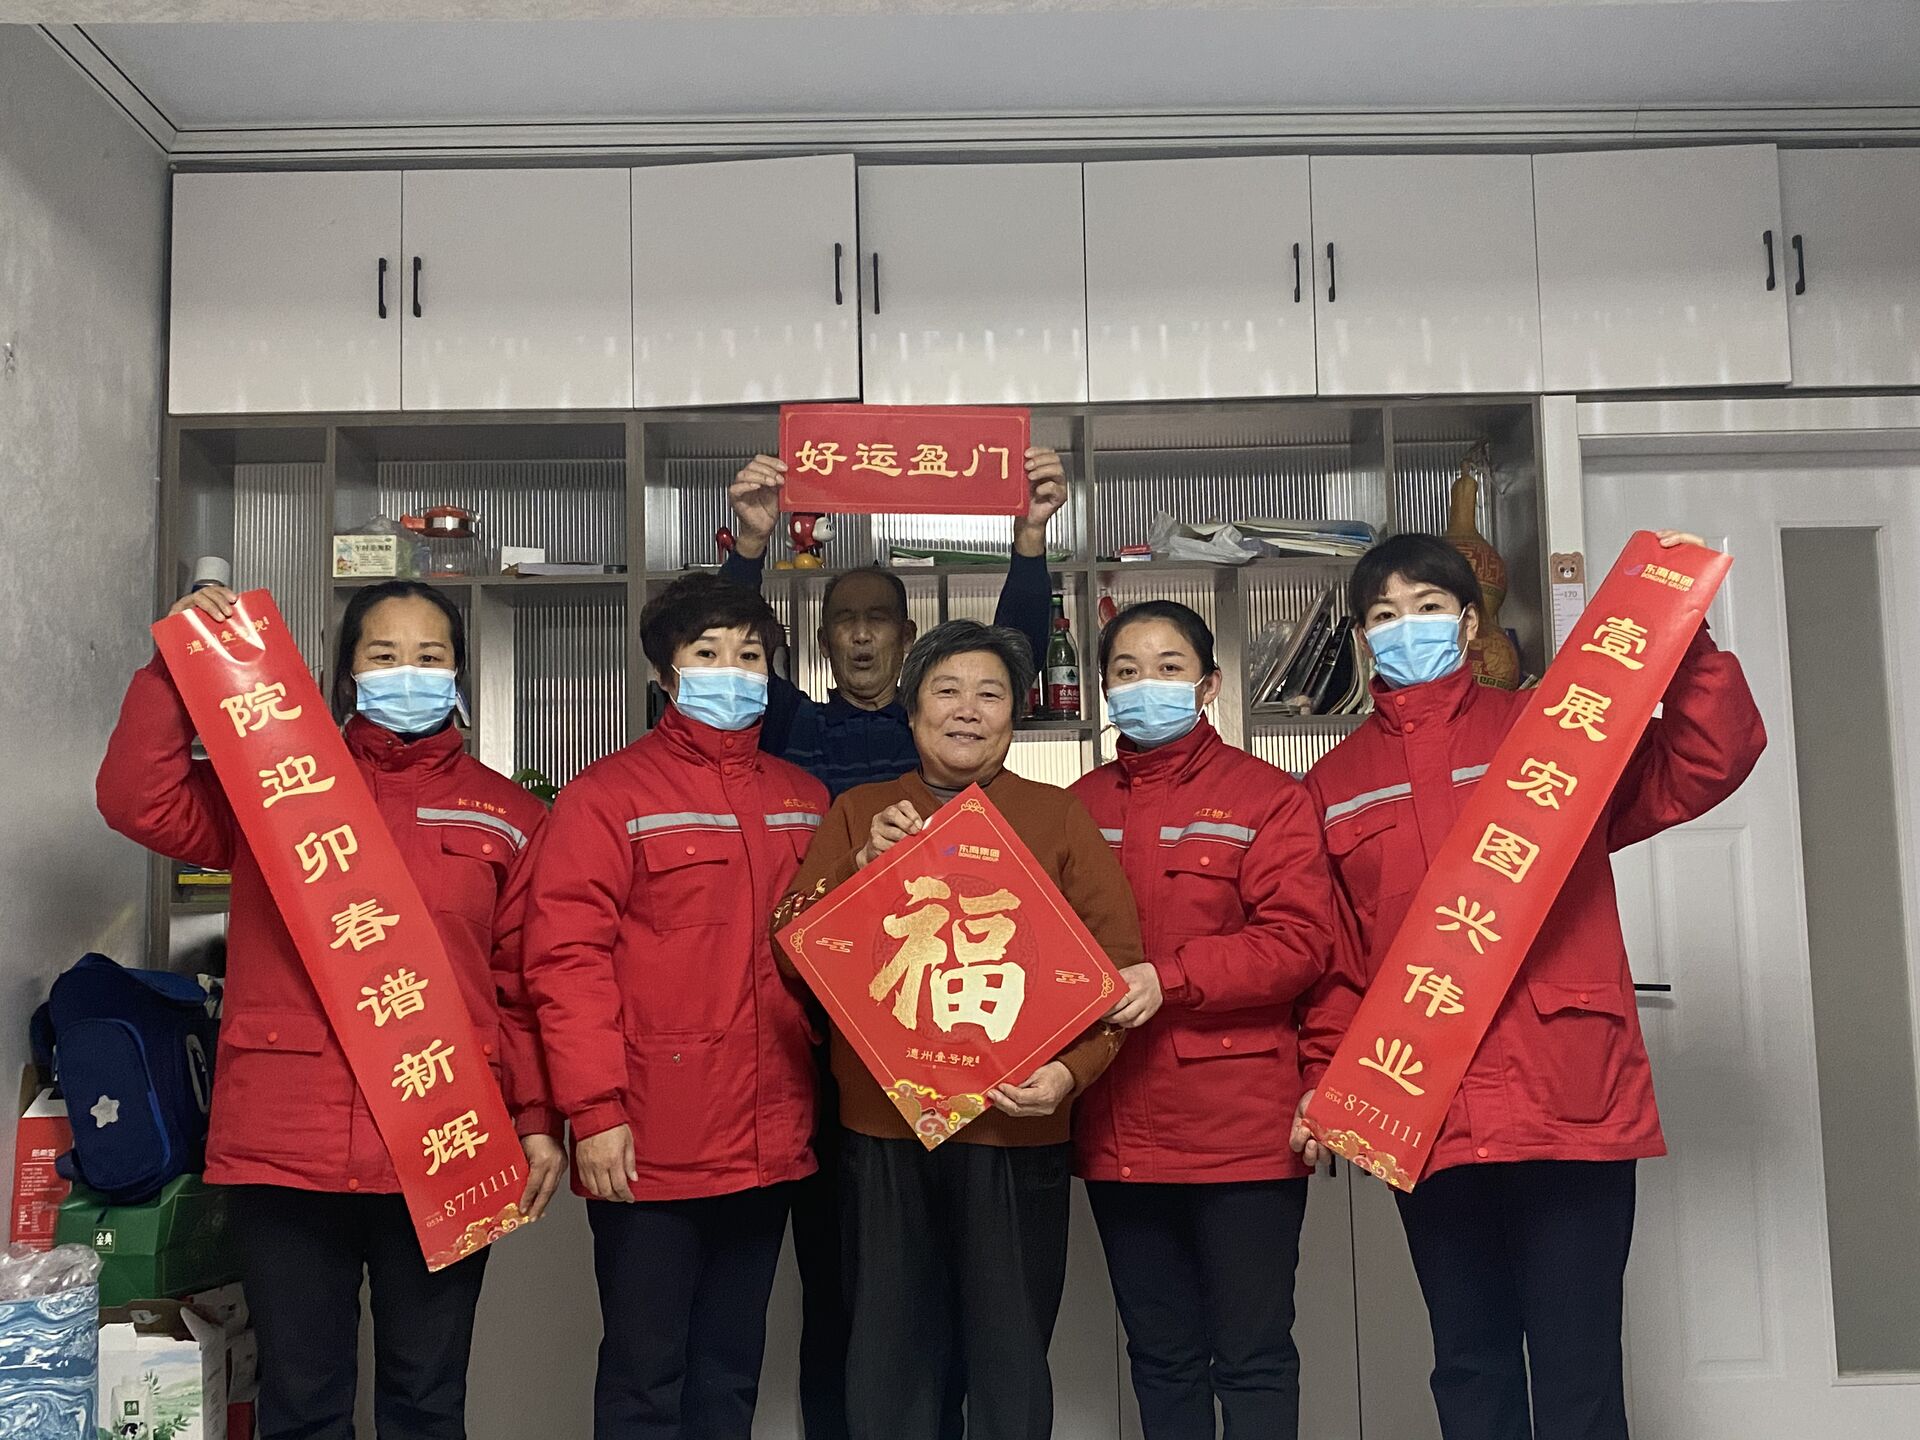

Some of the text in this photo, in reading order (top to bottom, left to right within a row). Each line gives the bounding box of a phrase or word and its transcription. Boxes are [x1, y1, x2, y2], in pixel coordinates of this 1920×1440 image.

[795, 440, 1010, 480] 好运盈门
[186, 619, 268, 655] 德壹院
[1358, 615, 1649, 1096] 壹展宏图兴伟业
[218, 680, 490, 1176] 院迎卯春谱新辉
[868, 875, 1026, 1043] 福
[1344, 1094, 1422, 1149] 8771111
[444, 1164, 520, 1218] 8771111
[95, 1232, 113, 1246] 金典
